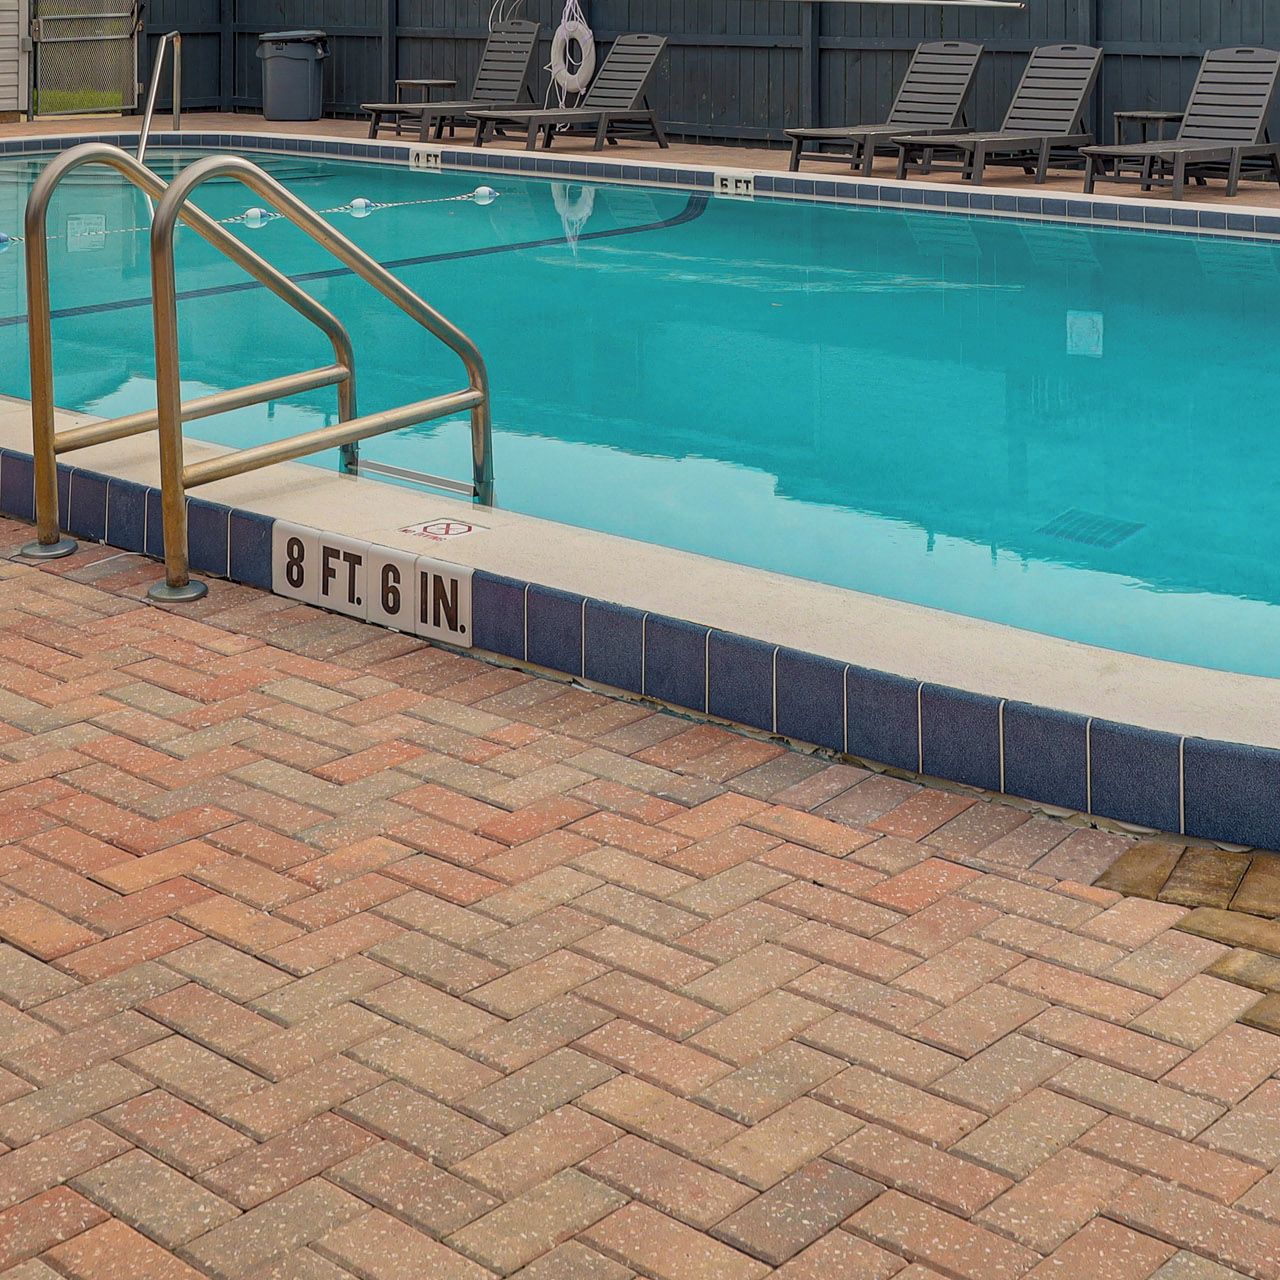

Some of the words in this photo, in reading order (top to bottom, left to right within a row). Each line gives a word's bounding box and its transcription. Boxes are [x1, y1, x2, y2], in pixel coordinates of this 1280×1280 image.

[285, 536, 306, 589] 8
[321, 545, 363, 606] FT.
[380, 563, 402, 615] 6
[419, 570, 467, 634] IN.
